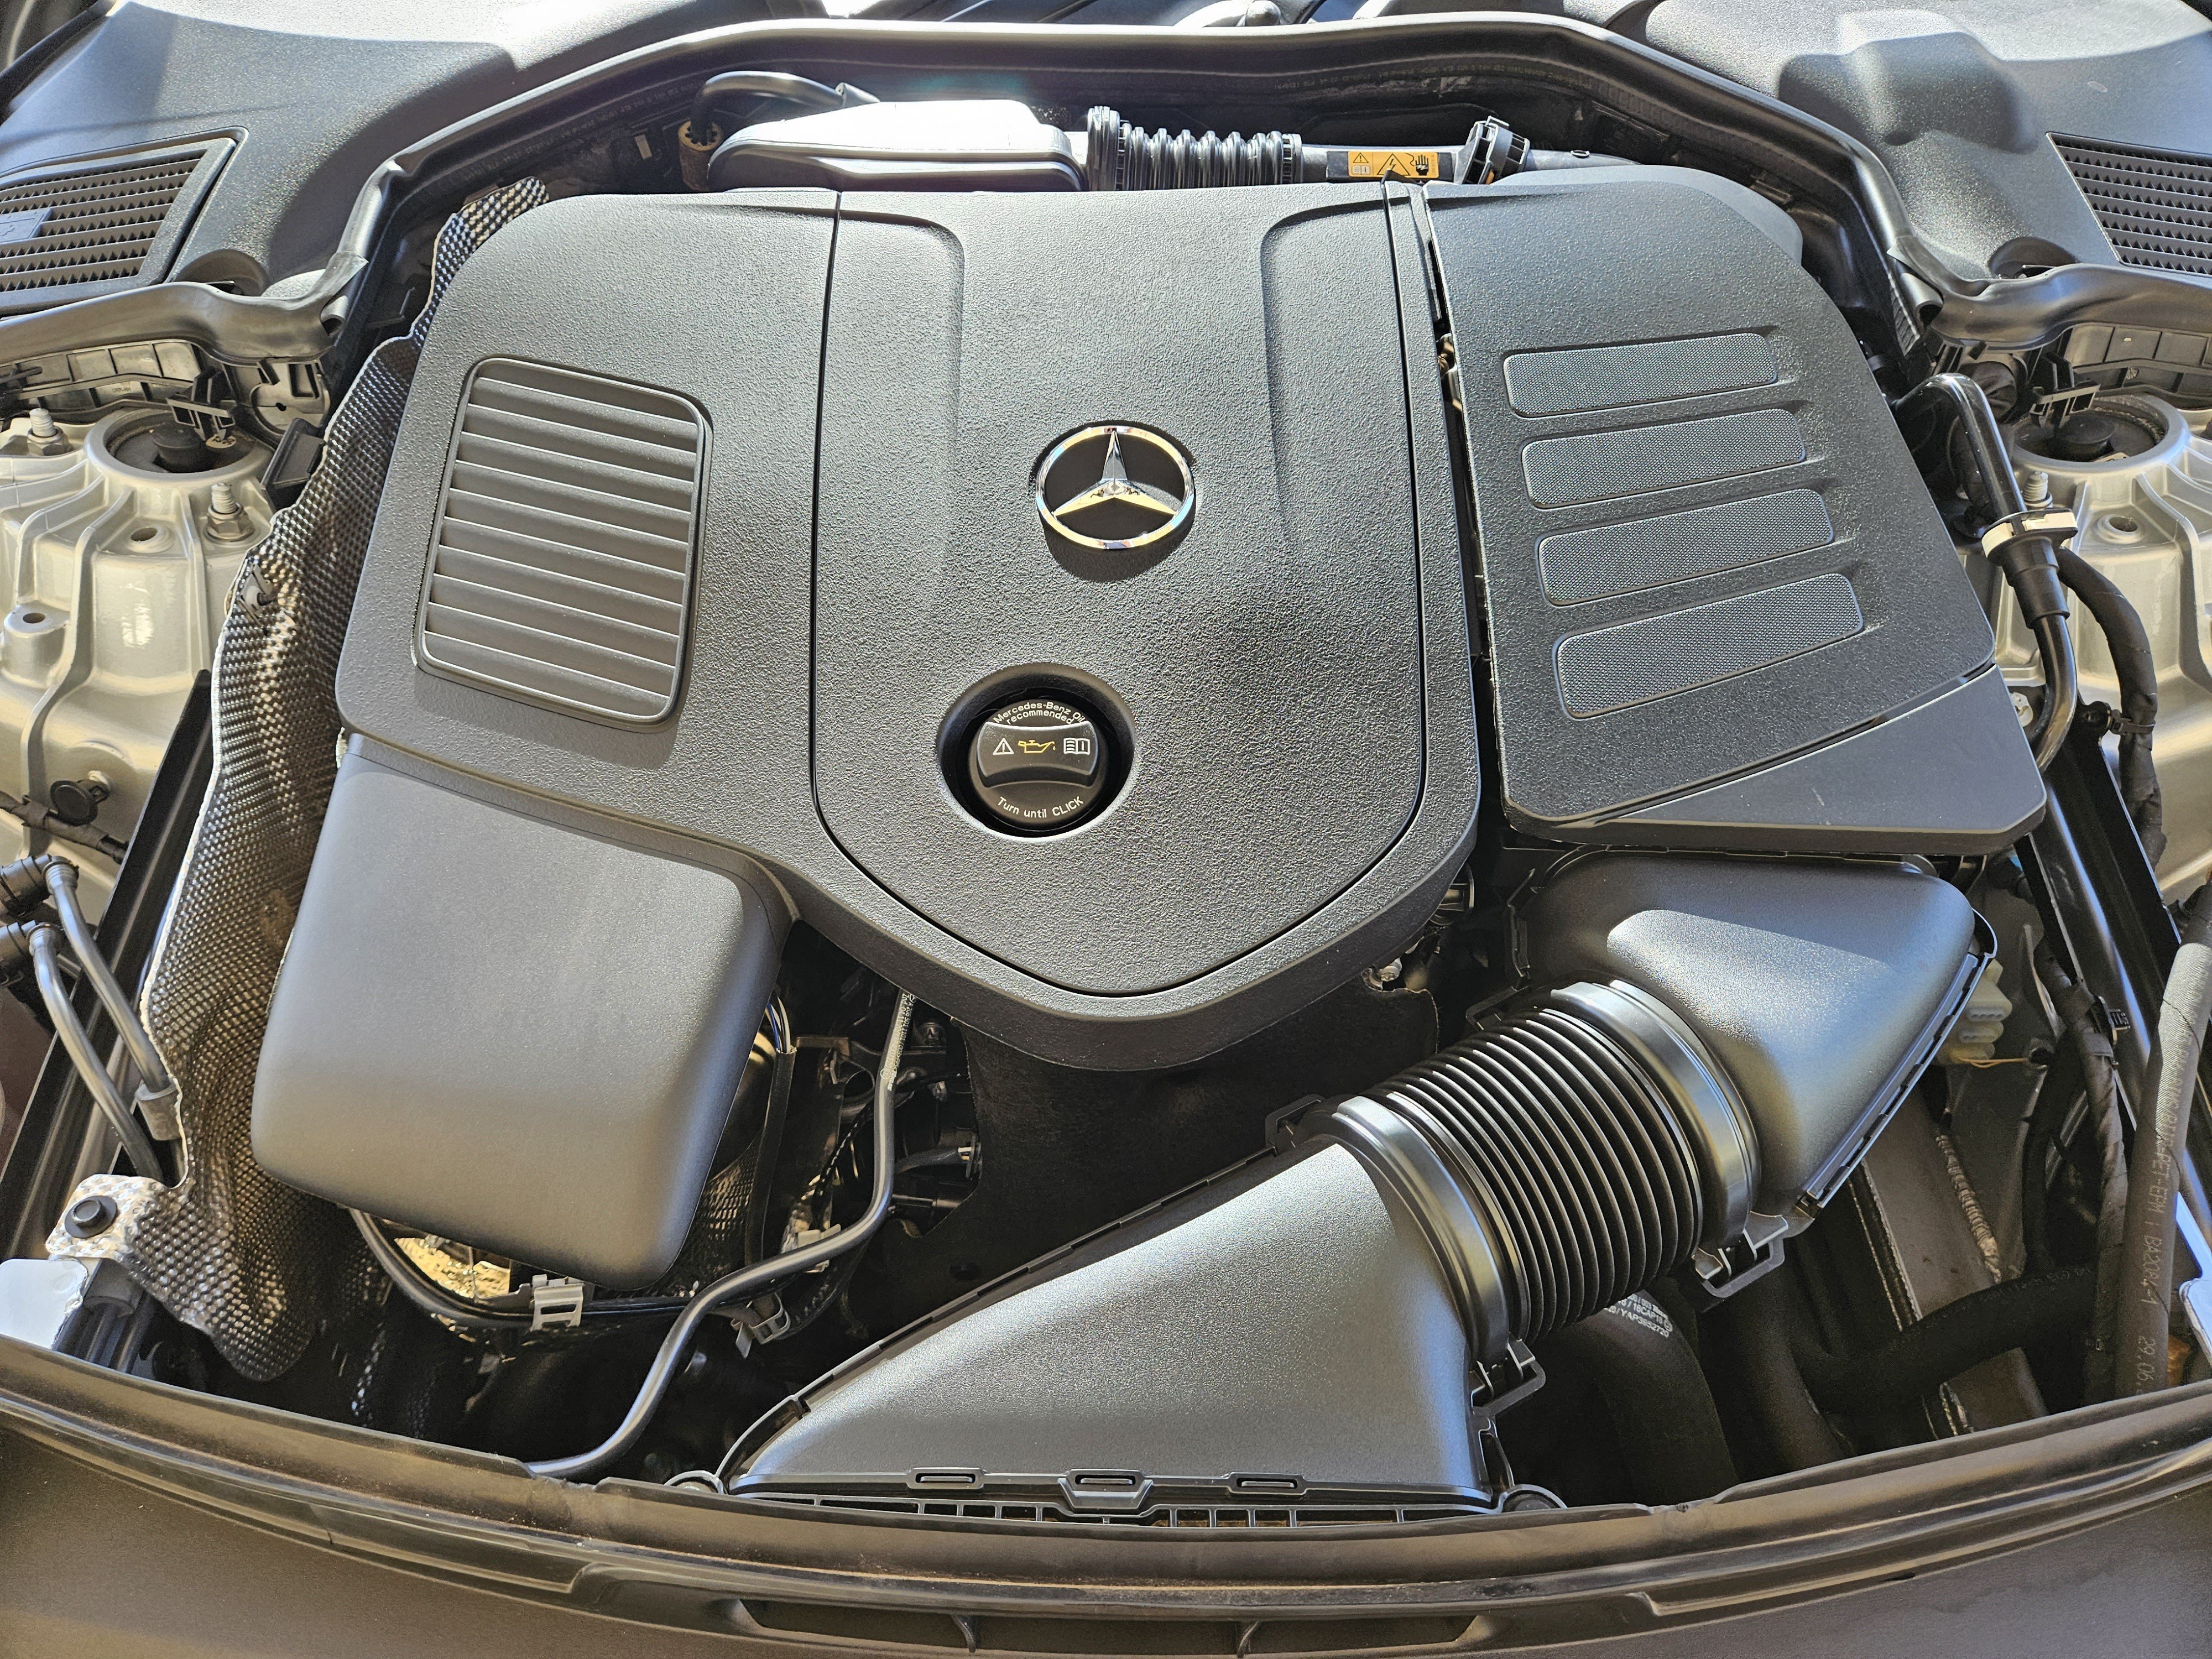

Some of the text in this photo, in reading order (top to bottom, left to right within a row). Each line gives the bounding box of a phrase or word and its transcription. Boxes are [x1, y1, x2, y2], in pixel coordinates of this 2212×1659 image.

[993, 701, 1071, 724] Mercedes-Benz
[1006, 709, 1074, 725] recommended
[998, 796, 1084, 818] Turn until CLICK
